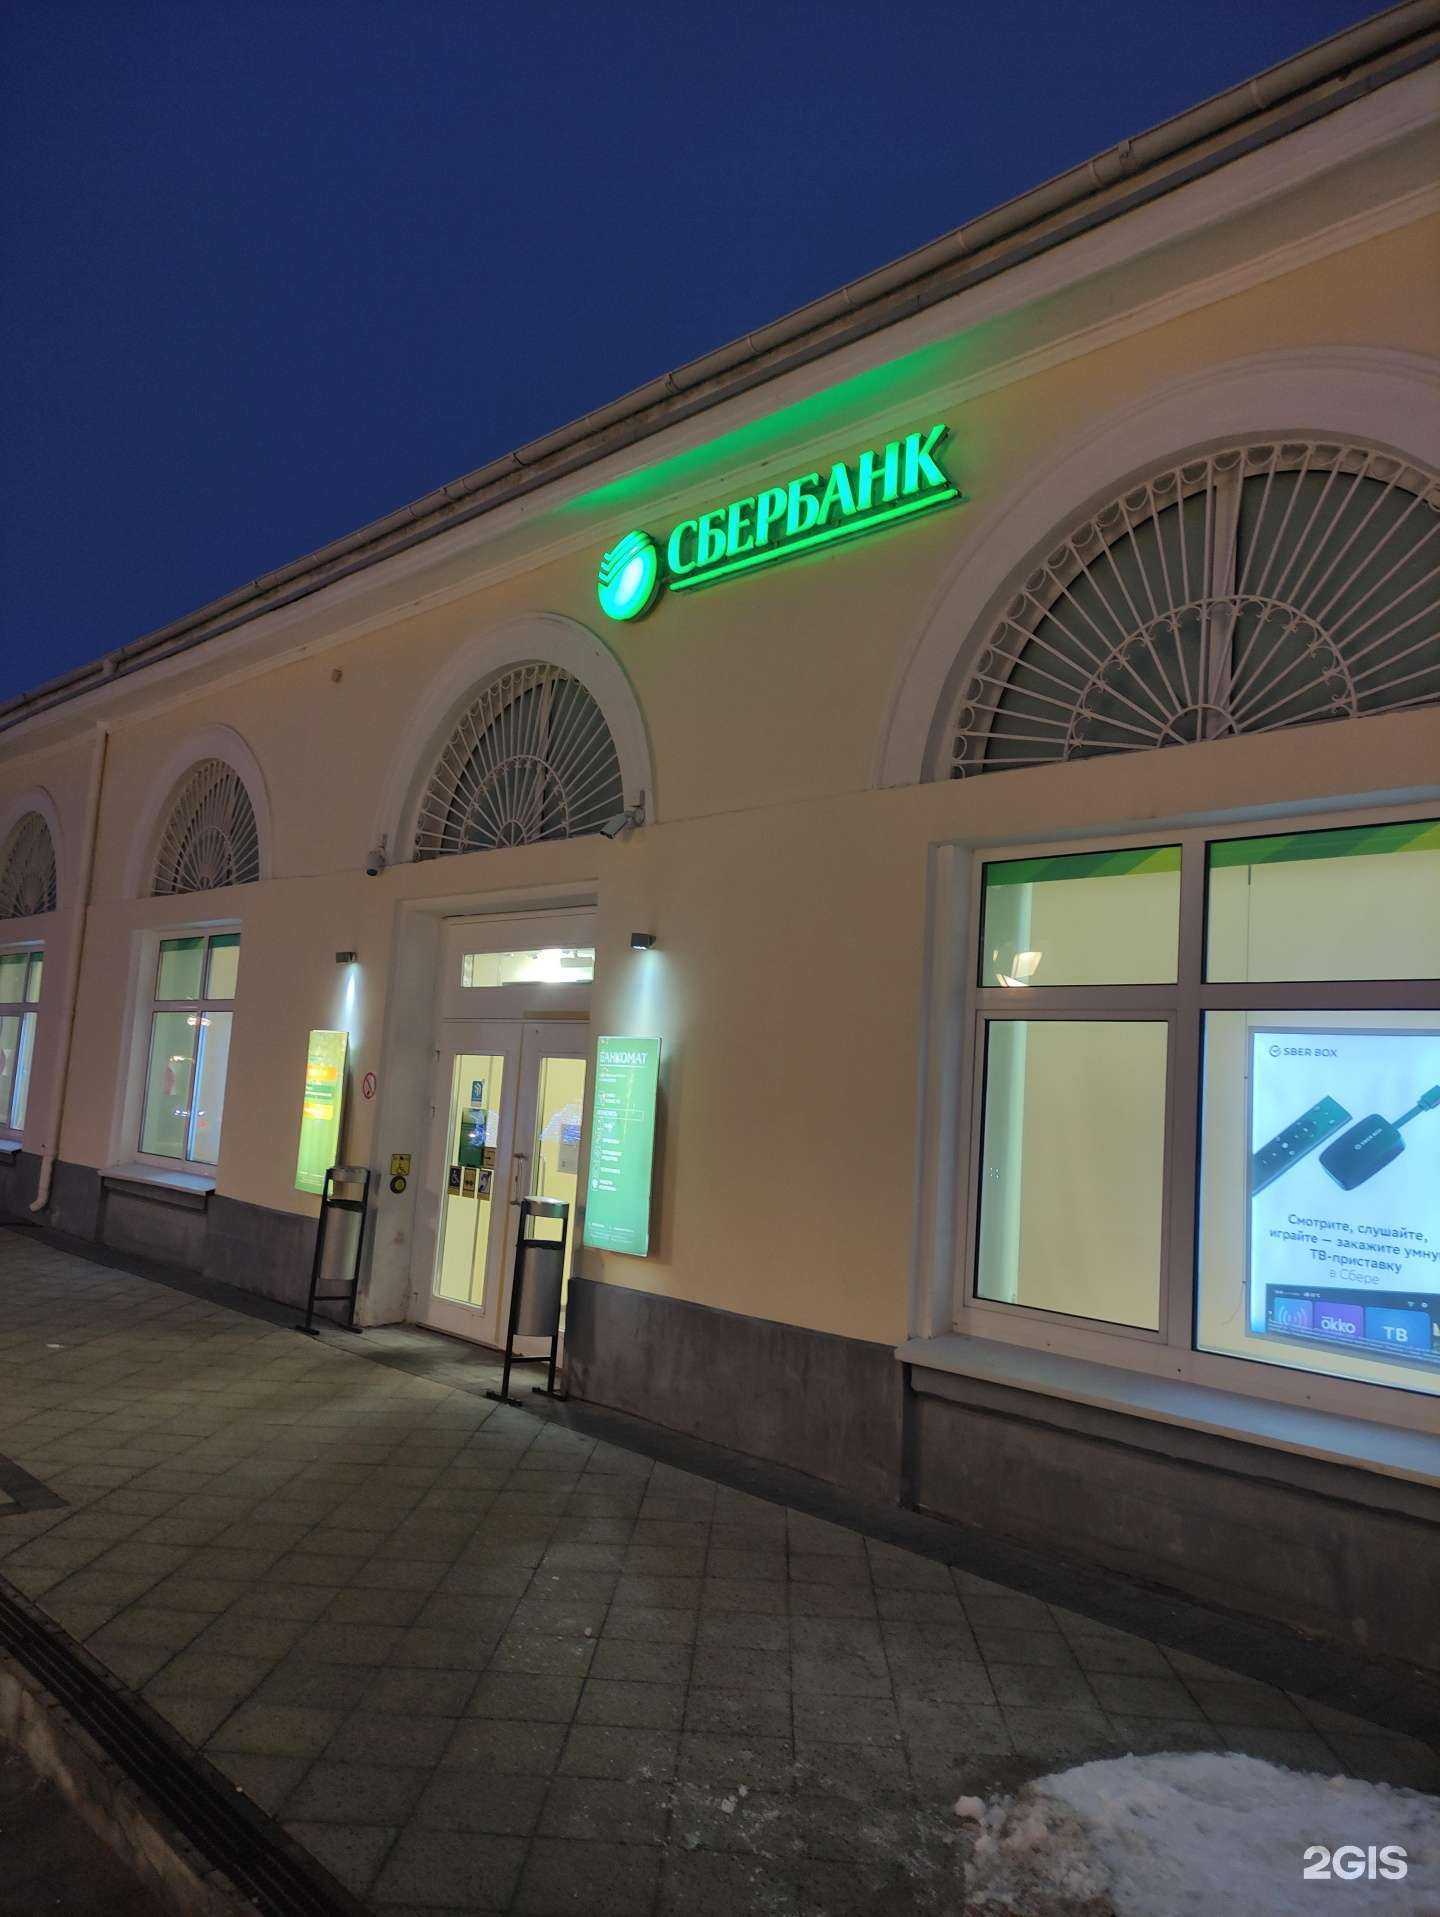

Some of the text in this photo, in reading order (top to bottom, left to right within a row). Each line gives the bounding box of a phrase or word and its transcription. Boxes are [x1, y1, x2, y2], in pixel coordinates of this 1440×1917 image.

[667, 424, 950, 575] СБЕРБАНК
[1283, 1047, 1338, 1058] SBER BOX
[1288, 1213, 1428, 1243] Смотрите, слушайте,
[1269, 1229, 1318, 1244] играйте
[1336, 1238, 1401, 1255] закажите
[1403, 1247, 1440, 1262] умну
[1310, 1248, 1402, 1275] ТВ-приставку
[1339, 1268, 1381, 1286] Сбере
